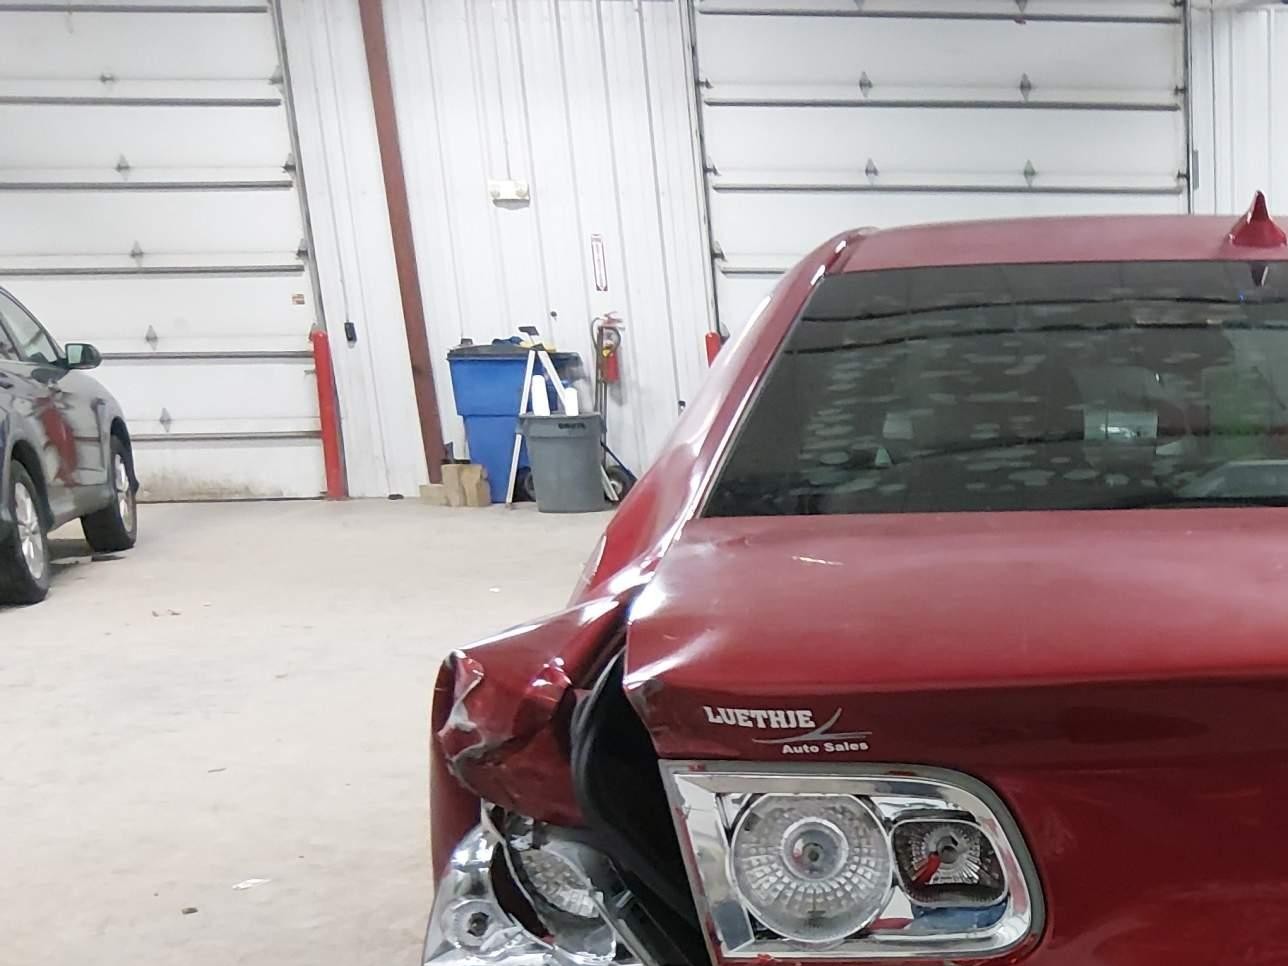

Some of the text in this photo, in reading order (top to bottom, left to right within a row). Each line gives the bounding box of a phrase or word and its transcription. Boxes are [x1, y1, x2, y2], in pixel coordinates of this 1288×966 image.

[703, 705, 816, 728] LUETHJE
[782, 742, 869, 754] Auto Sales
